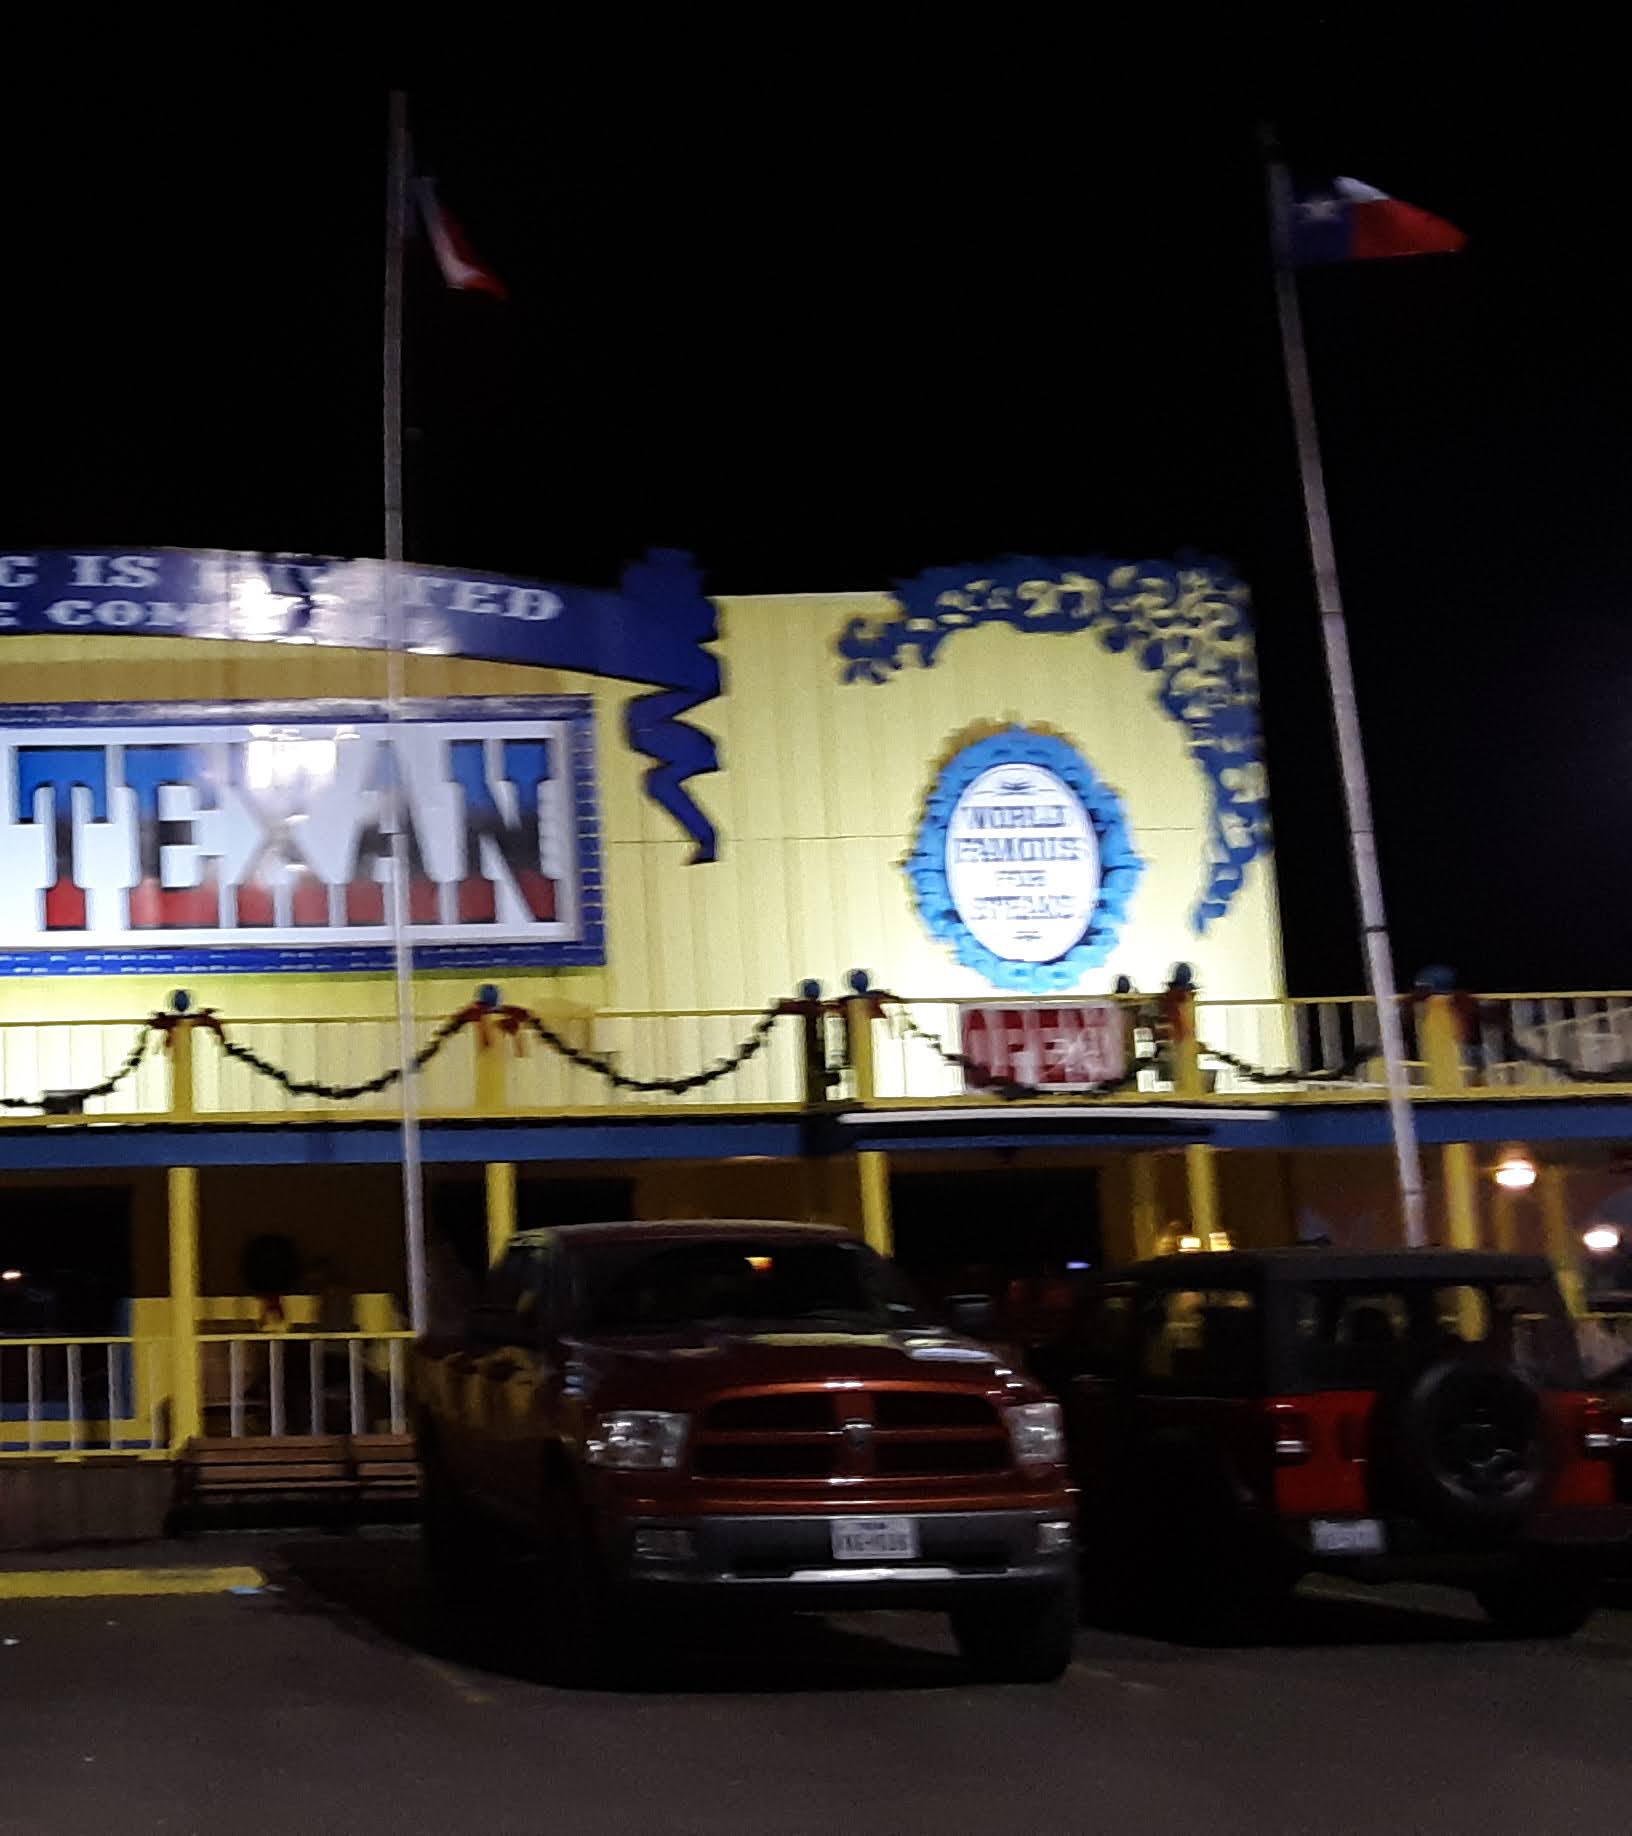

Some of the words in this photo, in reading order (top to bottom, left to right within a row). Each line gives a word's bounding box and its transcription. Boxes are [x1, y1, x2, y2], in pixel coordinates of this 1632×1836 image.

[69, 555, 161, 588] IS
[45, 600, 232, 631] COM
[960, 804, 1069, 829] WORLD
[18, 738, 558, 930] TEXAN
[953, 836, 1088, 863] FAMOUS
